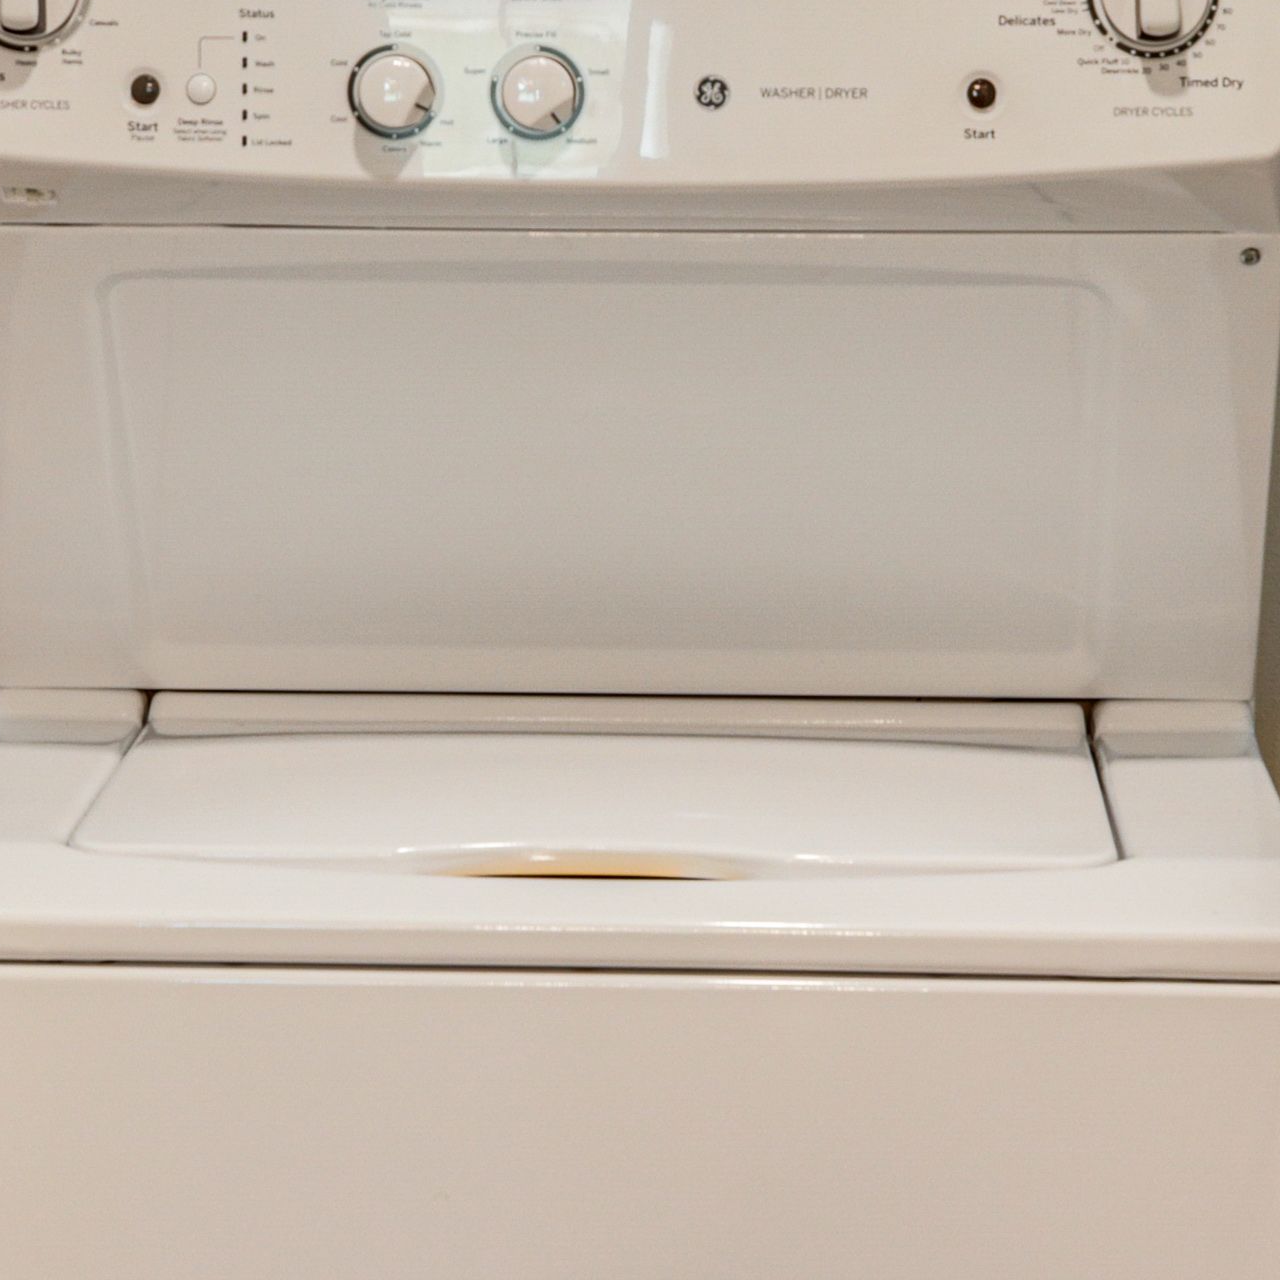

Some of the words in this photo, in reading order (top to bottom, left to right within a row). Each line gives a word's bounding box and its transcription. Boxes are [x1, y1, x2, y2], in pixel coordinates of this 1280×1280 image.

[239, 8, 274, 19] Status
[998, 15, 1056, 26] Delicates
[1179, 76, 1218, 88] Timed
[1223, 76, 1244, 90] Dry
[760, 87, 815, 98] WASHER
[825, 87, 868, 99] DRYER
[30, 100, 70, 110] CYCLES
[1113, 107, 1149, 117] DRYER
[1152, 107, 1194, 117] CYCLES
[128, 121, 158, 132] Start
[964, 128, 996, 140] Start
